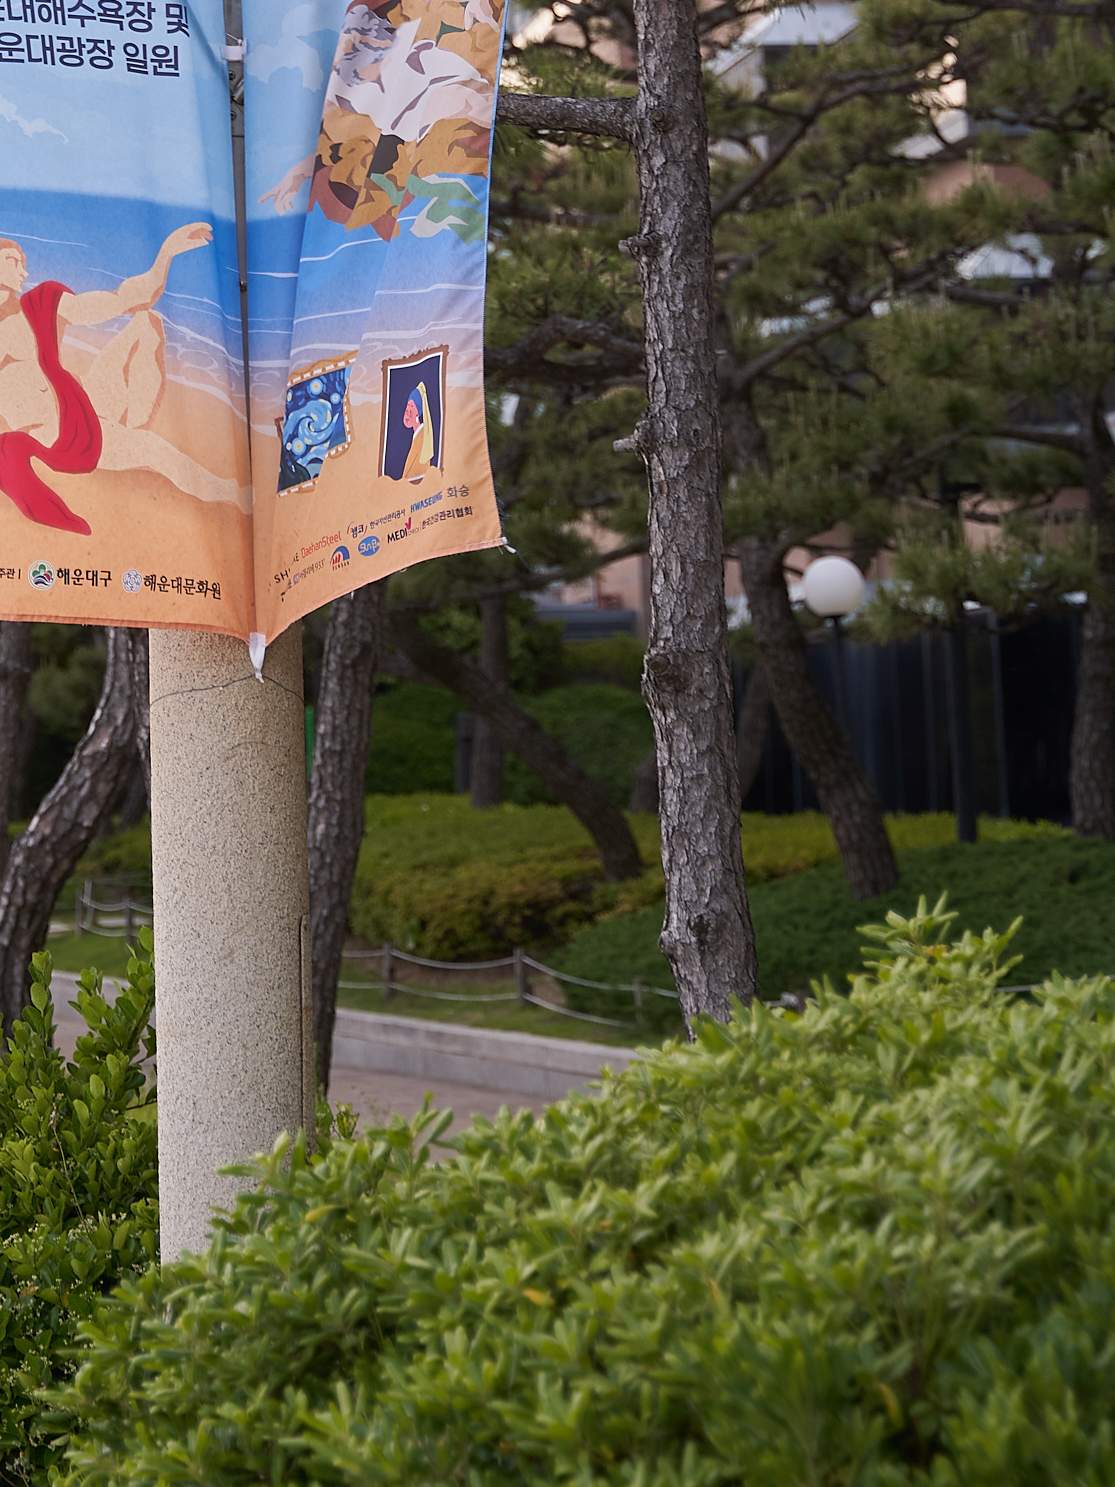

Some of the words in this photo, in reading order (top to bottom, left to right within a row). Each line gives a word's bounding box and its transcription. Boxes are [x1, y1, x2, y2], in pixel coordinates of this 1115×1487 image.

[165, 2, 190, 38] 및
[125, 42, 181, 77] 일원
[446, 484, 470, 499] 화승
[56, 567, 113, 587] 해운대구
[143, 574, 222, 600] 해운대문화원
